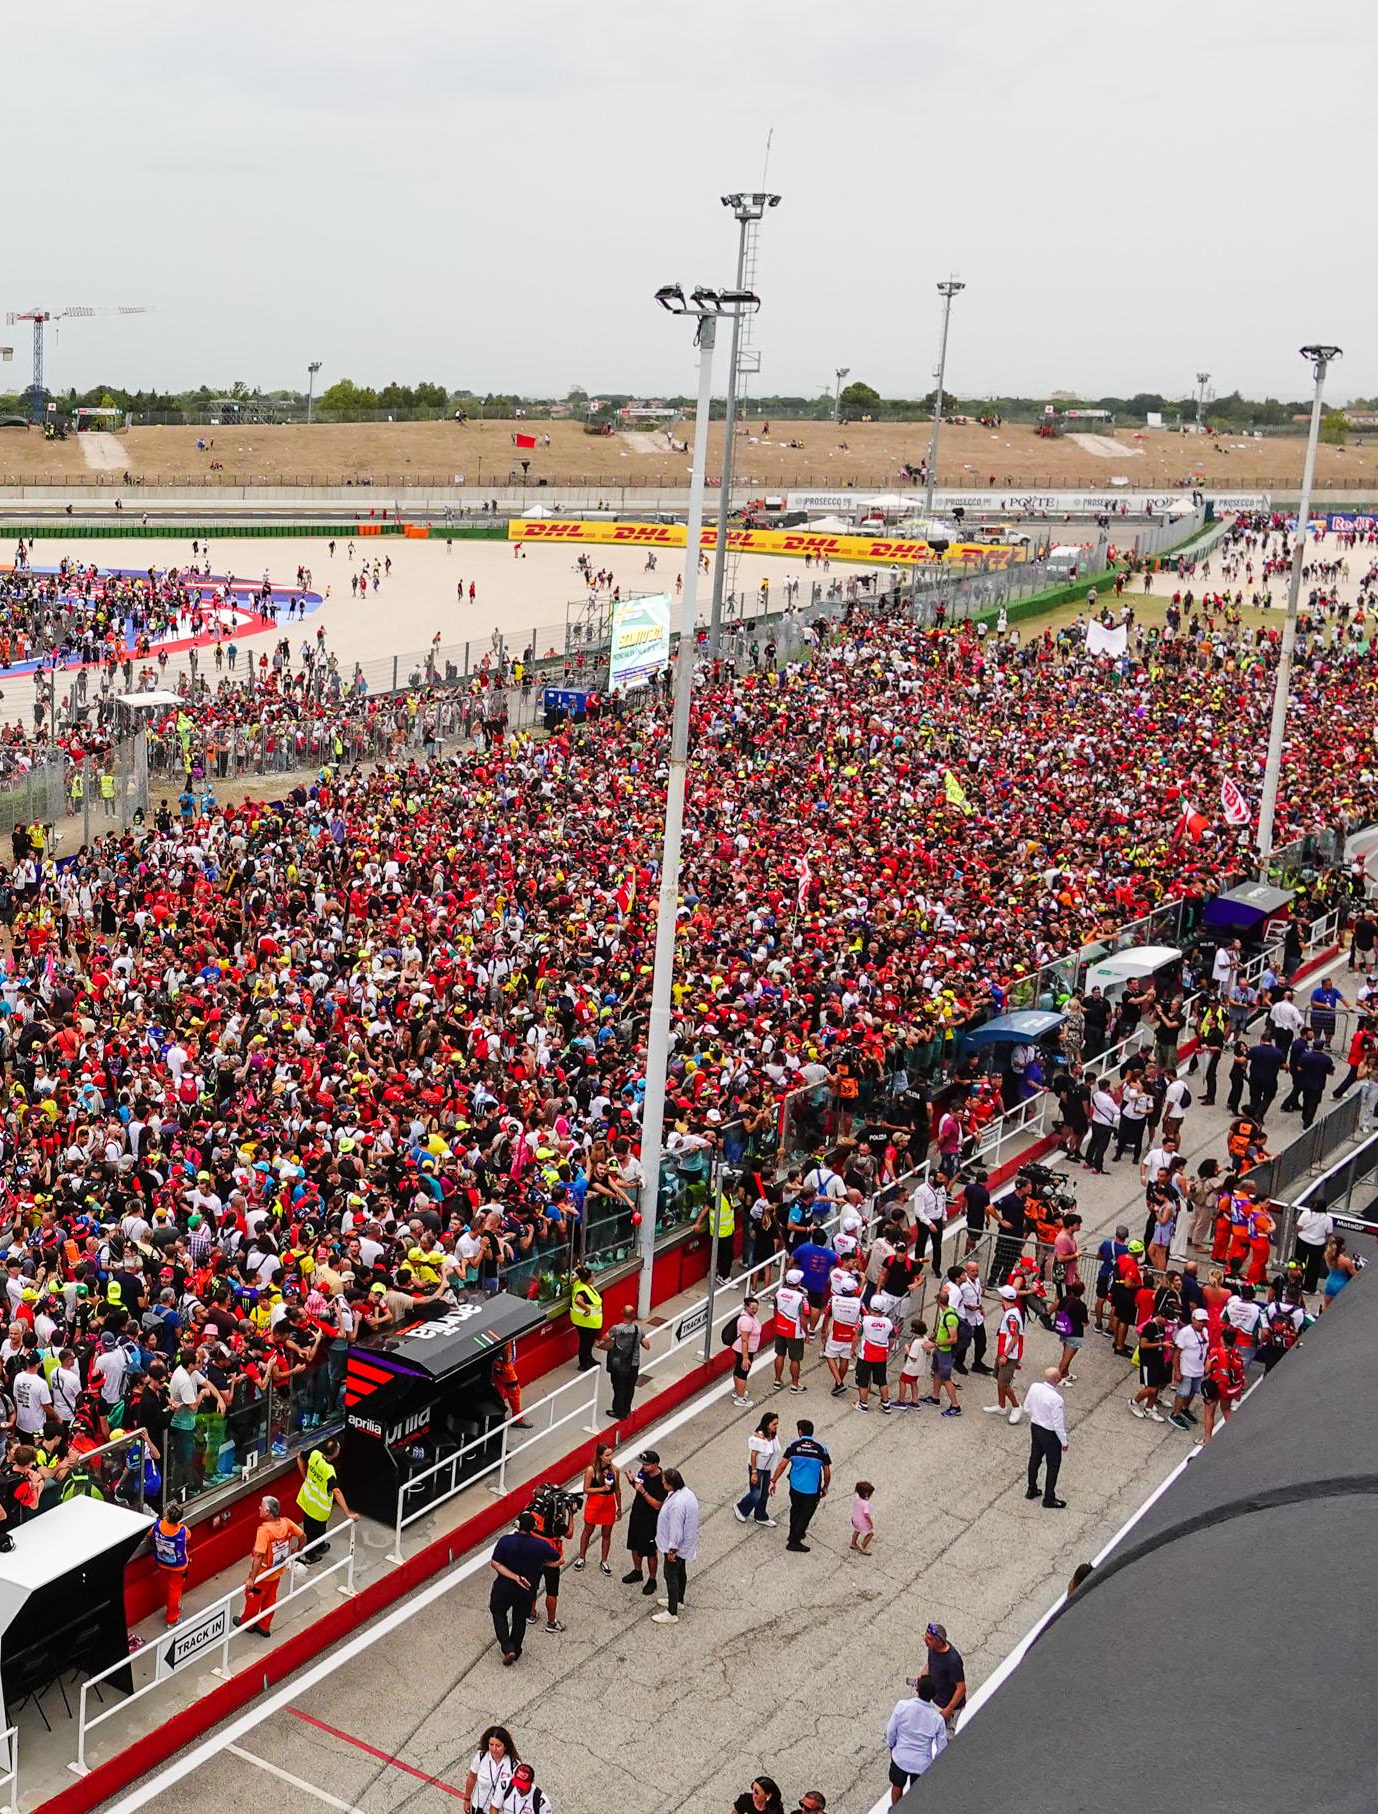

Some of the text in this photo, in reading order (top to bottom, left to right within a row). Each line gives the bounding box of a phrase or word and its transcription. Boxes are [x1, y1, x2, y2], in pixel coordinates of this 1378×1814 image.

[805, 498, 842, 506] PROSECCO
[945, 498, 982, 506] PROSECCO
[1219, 499, 1254, 507] PROSECCO
[524, 524, 586, 538] DHL
[613, 526, 671, 541] DHL
[783, 536, 841, 553] DHL
[959, 548, 1022, 564] DHL
[869, 1133, 887, 1141] POLIZIA
[1336, 1219, 1365, 1232] MotoGP
[405, 1304, 483, 1340] aprilia
[682, 1317, 701, 1334] TRACK
[348, 1414, 382, 1436] aprilia
[177, 1620, 222, 1656] TRACK IN
